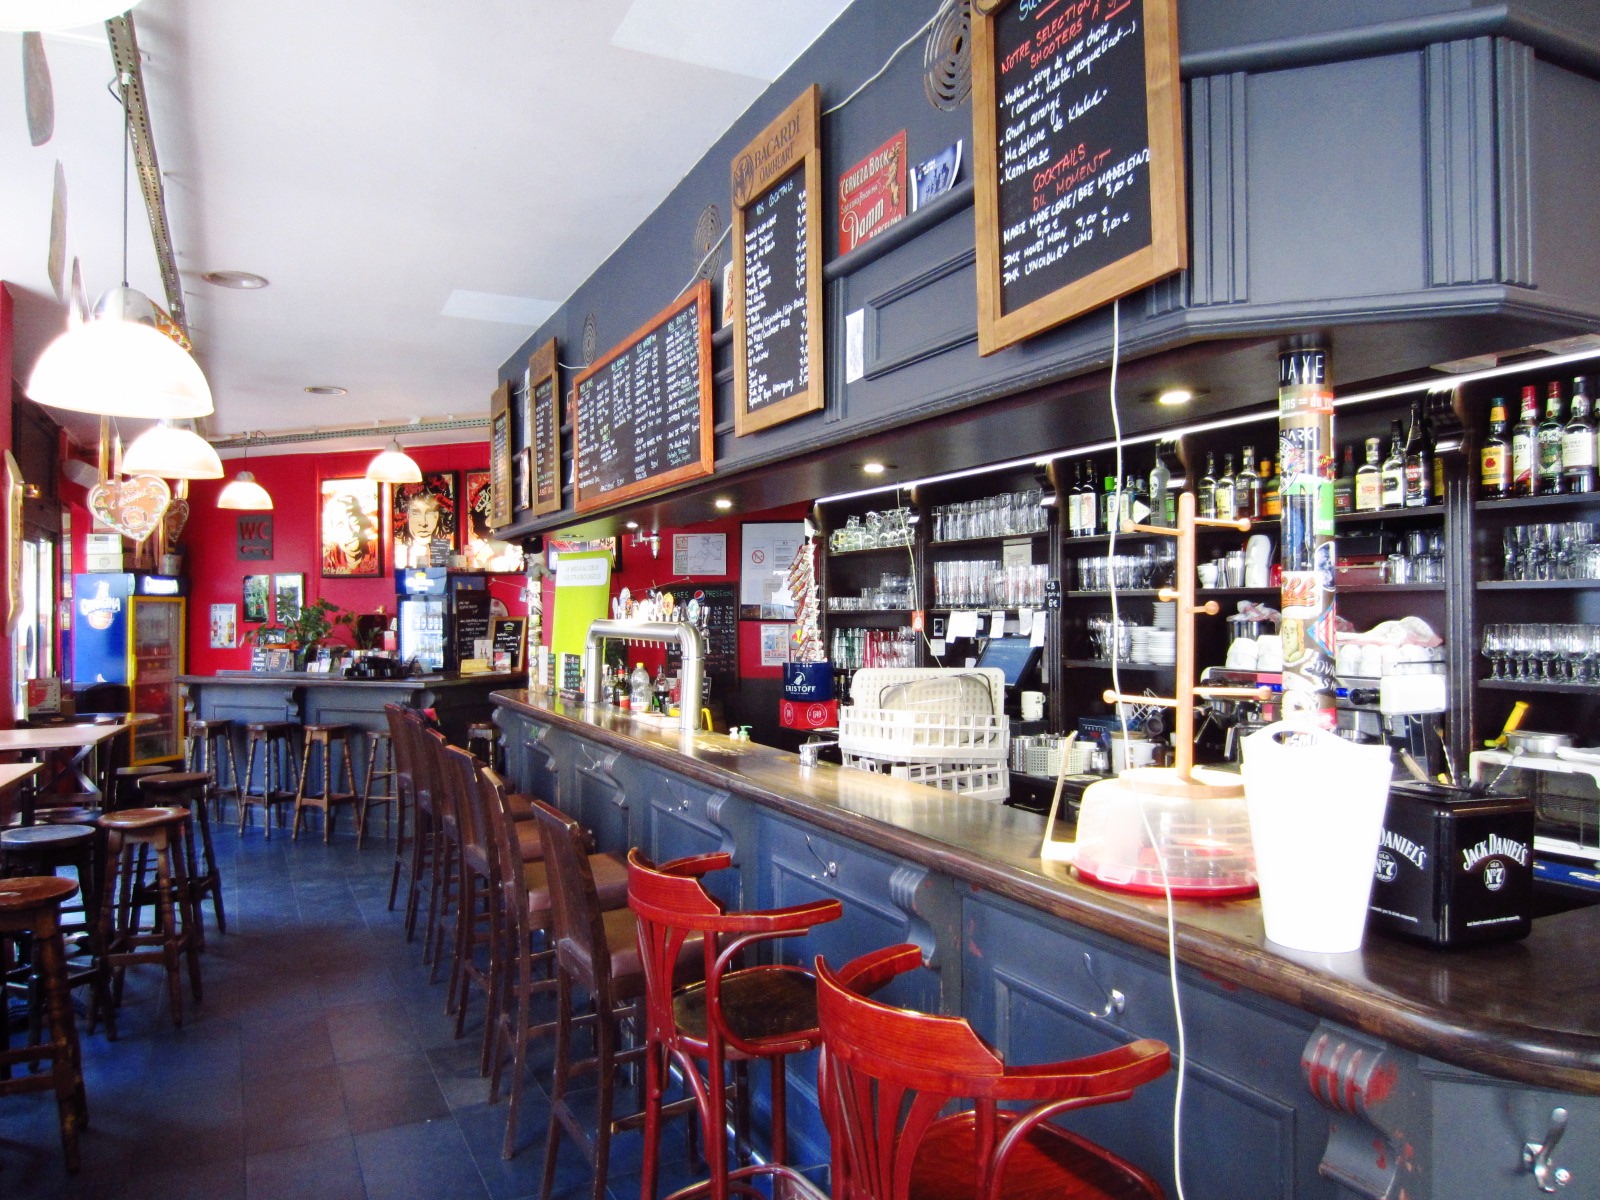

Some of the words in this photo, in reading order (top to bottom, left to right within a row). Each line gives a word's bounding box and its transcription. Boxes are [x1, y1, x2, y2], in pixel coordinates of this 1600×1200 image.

[1001, 40, 1031, 74] NOTRE
[1036, 0, 1090, 47] SELECTION
[1030, 17, 1083, 69] SHOOTERS
[1066, 40, 1084, 62] votre
[840, 164, 869, 202] CERVEZA
[1056, 148, 1111, 196] MOMENT
[842, 198, 884, 250] Damm
[240, 521, 270, 540] WC
[785, 685, 817, 693] ERISTOFF
[1462, 840, 1489, 871] JACK
[1488, 833, 1528, 865] DANIEL'S
